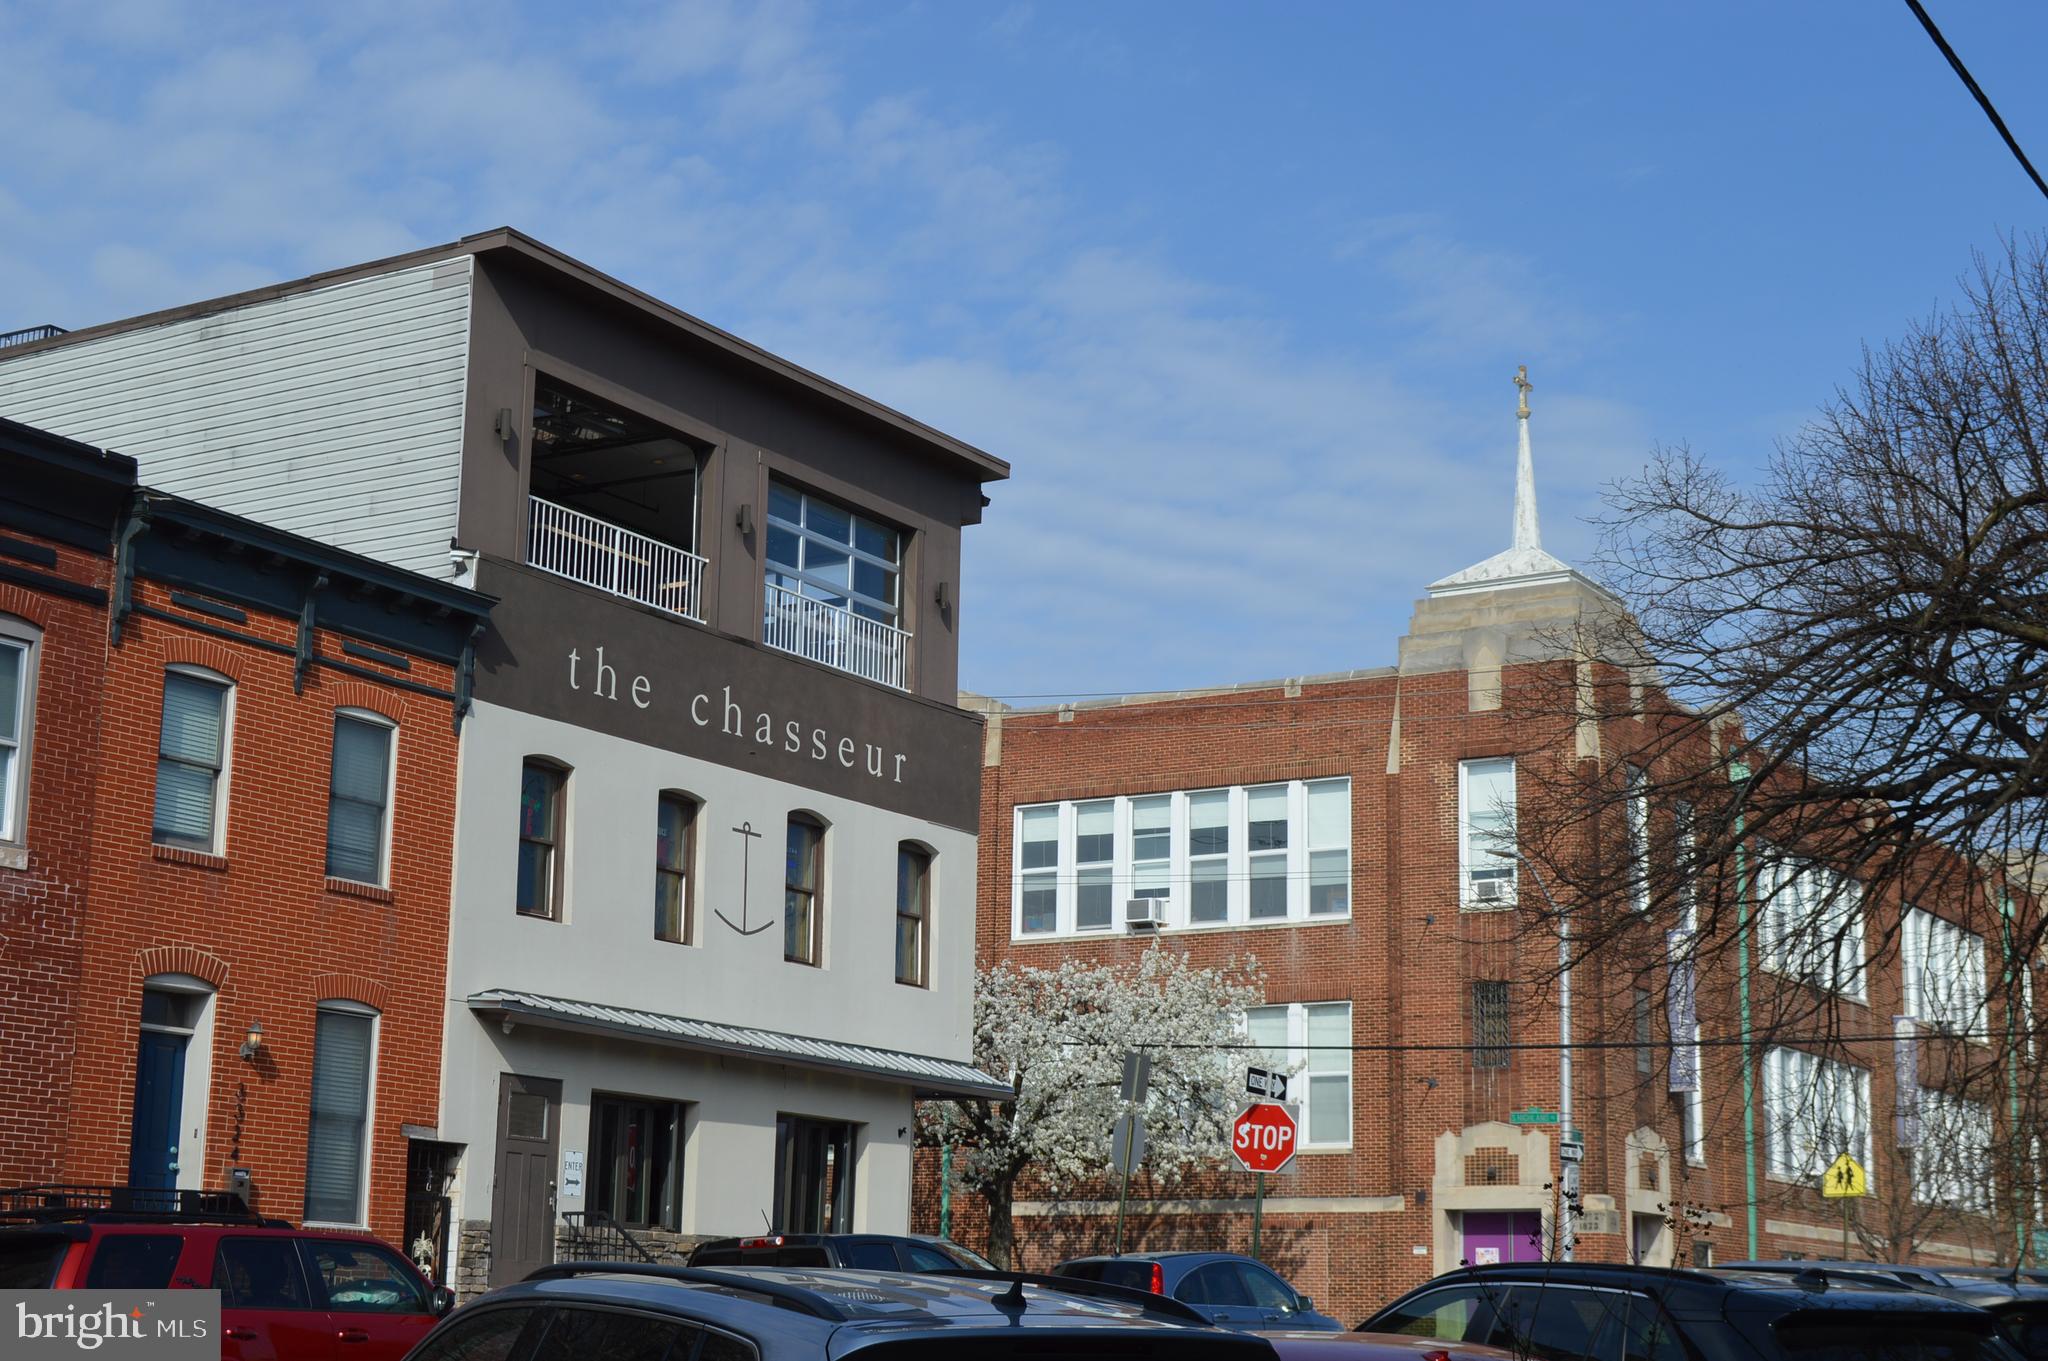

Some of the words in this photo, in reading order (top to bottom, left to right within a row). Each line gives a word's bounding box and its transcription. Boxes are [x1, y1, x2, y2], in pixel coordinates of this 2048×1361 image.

[568, 646, 651, 709] the
[690, 685, 907, 783] chasseur
[1250, 1074, 1264, 1088] ONE
[1236, 1122, 1292, 1151] STOP
[564, 1160, 583, 1171] ENTER
